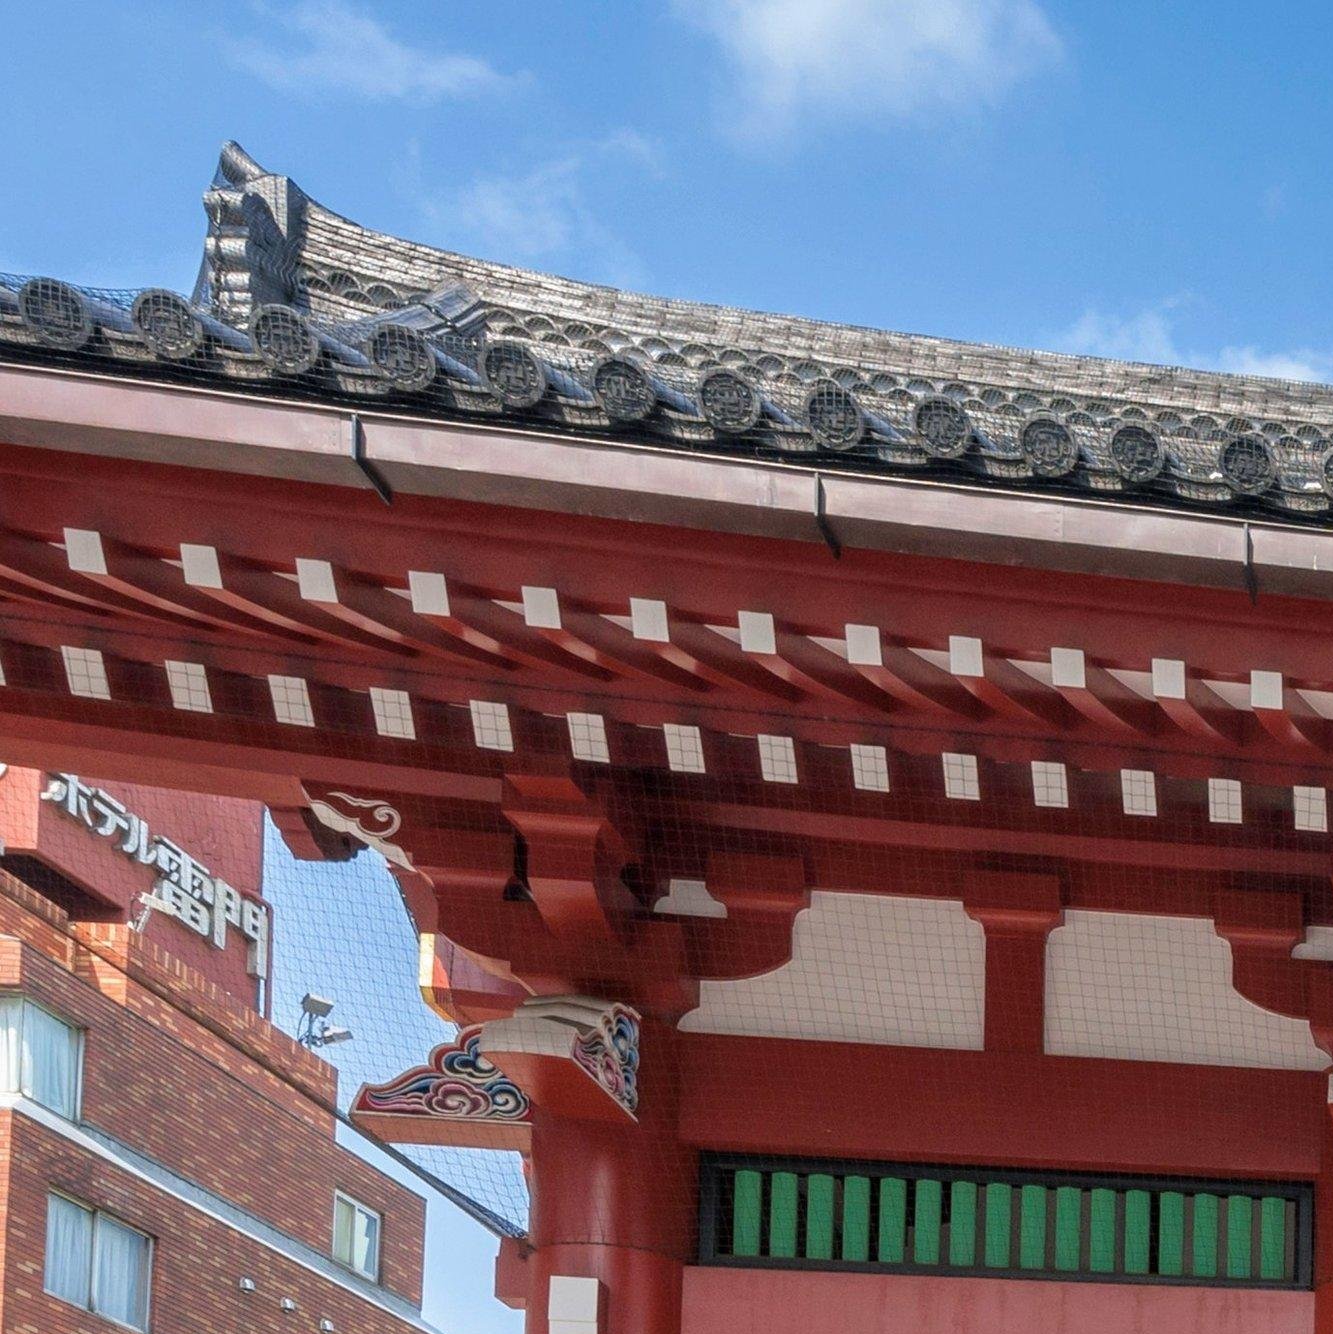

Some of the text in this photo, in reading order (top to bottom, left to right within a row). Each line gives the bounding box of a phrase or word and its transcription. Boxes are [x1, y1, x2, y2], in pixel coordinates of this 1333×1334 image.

[41, 773, 267, 979] ホテル雷門
